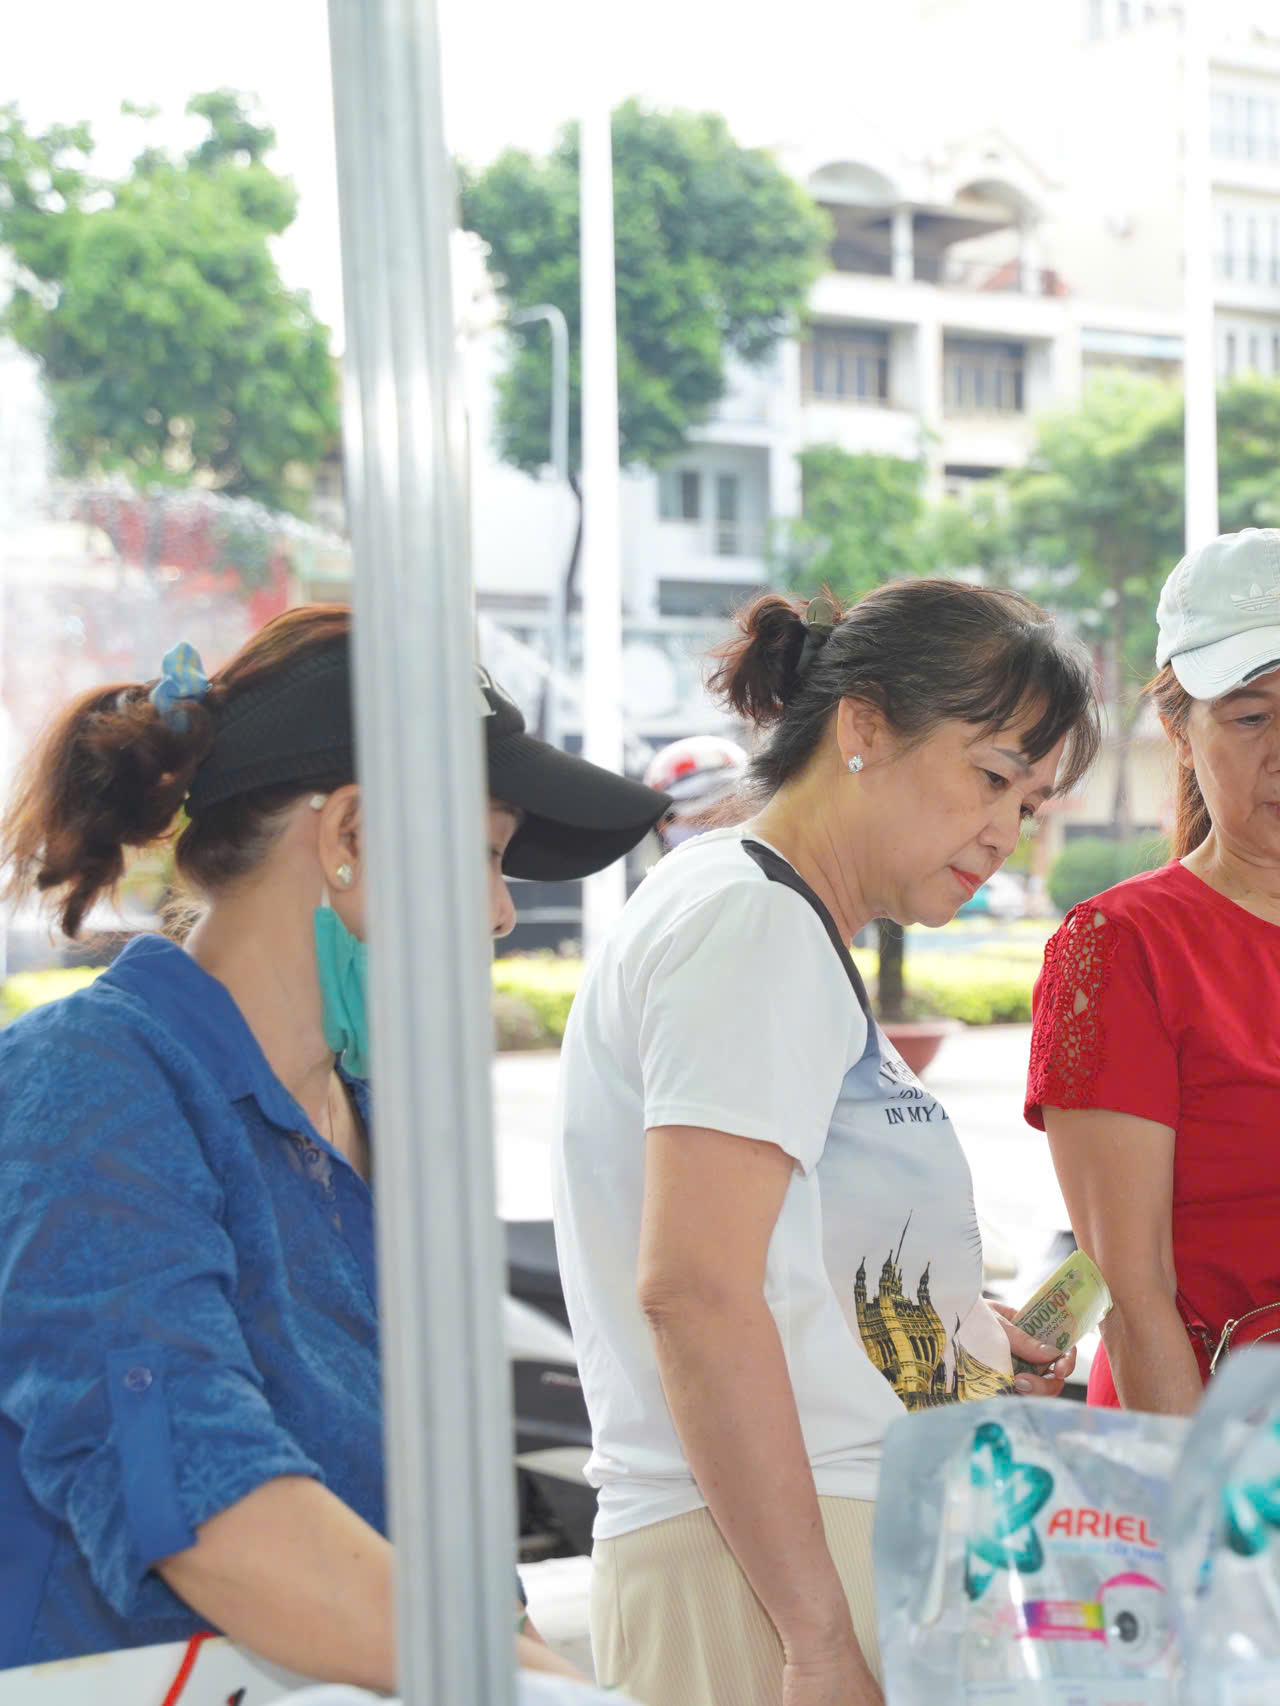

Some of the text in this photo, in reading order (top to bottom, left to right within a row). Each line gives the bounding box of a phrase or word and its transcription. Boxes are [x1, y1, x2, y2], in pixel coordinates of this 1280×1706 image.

[884, 1107, 905, 1125] IN
[907, 1102, 937, 1123] MY
[1047, 1507, 1159, 1549] ARIEL
